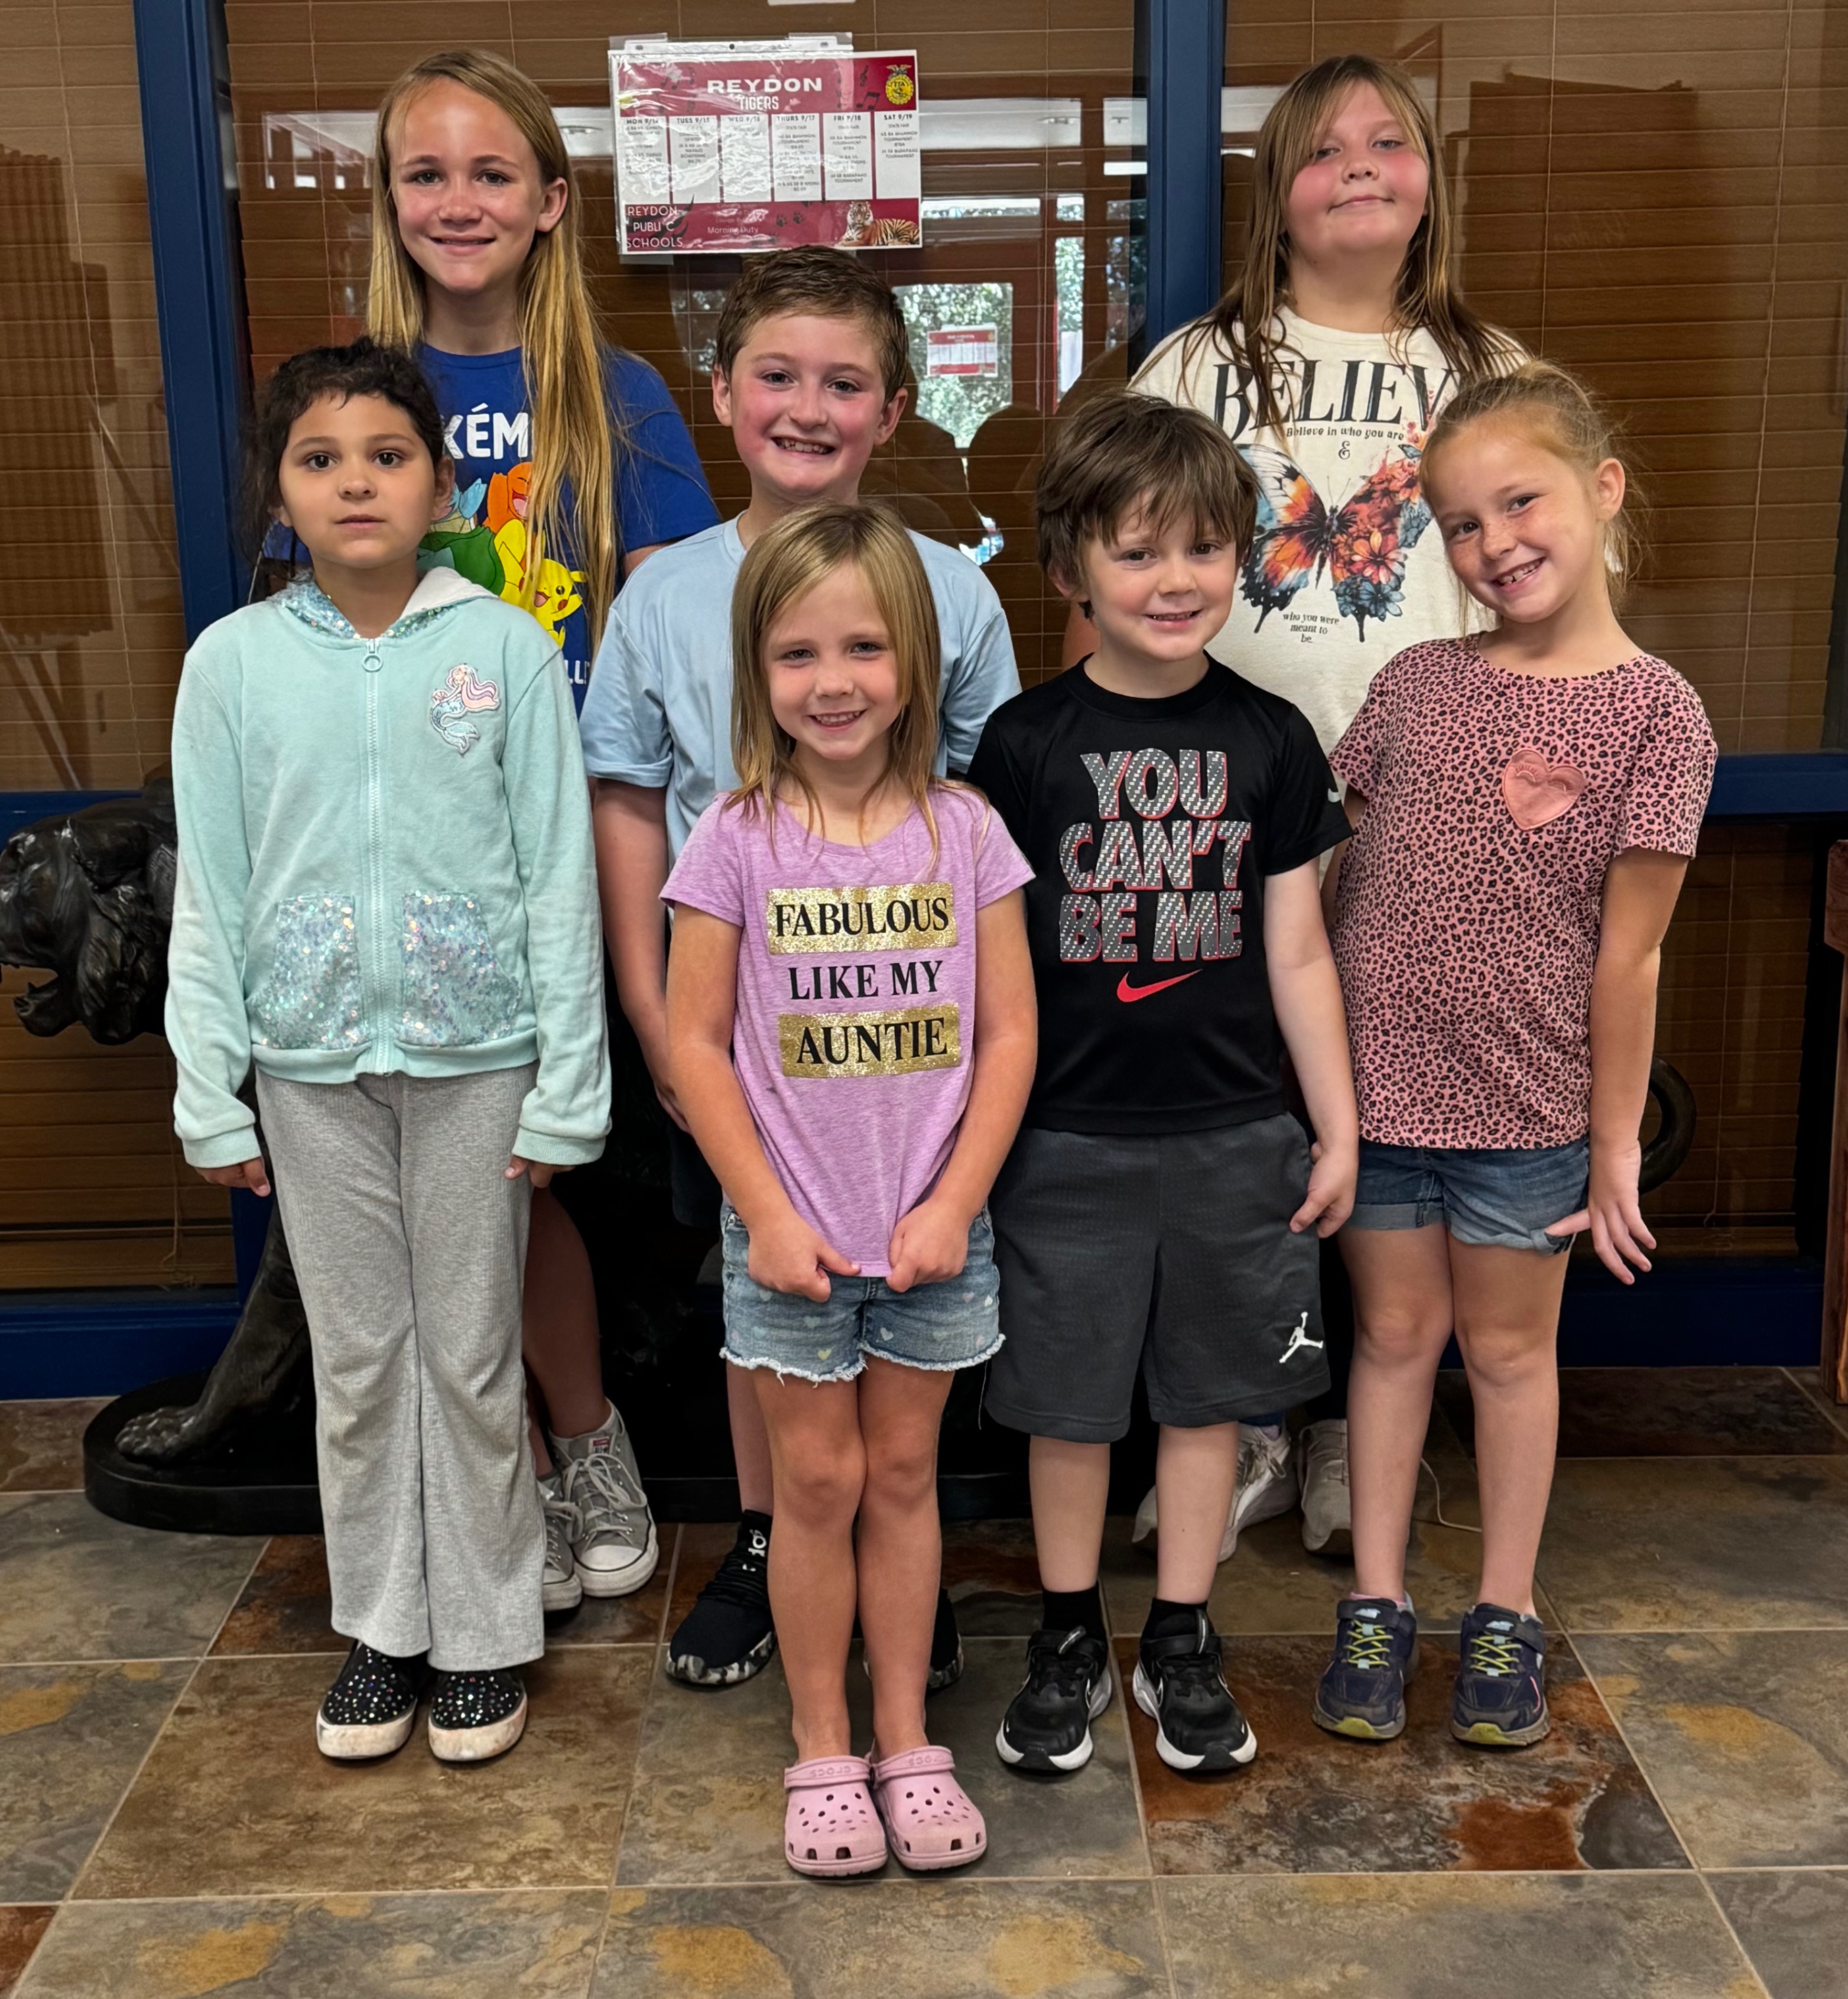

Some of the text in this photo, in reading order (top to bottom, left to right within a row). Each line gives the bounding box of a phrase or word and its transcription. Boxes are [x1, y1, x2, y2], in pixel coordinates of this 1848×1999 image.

[707, 77, 822, 93] REYDON
[739, 96, 779, 111] TIGERS
[628, 206, 678, 216] REYDON
[707, 226, 759, 235] Morning Duty
[626, 237, 683, 248] SCHOOLS
[1213, 359, 1460, 442] BELIEV
[440, 403, 528, 459] KÉM
[1287, 426, 1404, 441] Believe in who you are
[1338, 440, 1350, 460] &
[1283, 611, 1340, 625] who you were
[1290, 624, 1328, 635] meant to
[1301, 633, 1313, 643] be
[1080, 748, 1228, 819] YOU
[1059, 820, 1251, 892] CAN'T
[775, 897, 949, 937] FABULOUS
[1060, 890, 1243, 962] BE ME
[788, 960, 943, 1000] LIKE MY
[796, 1017, 947, 1065] AUNTIE
